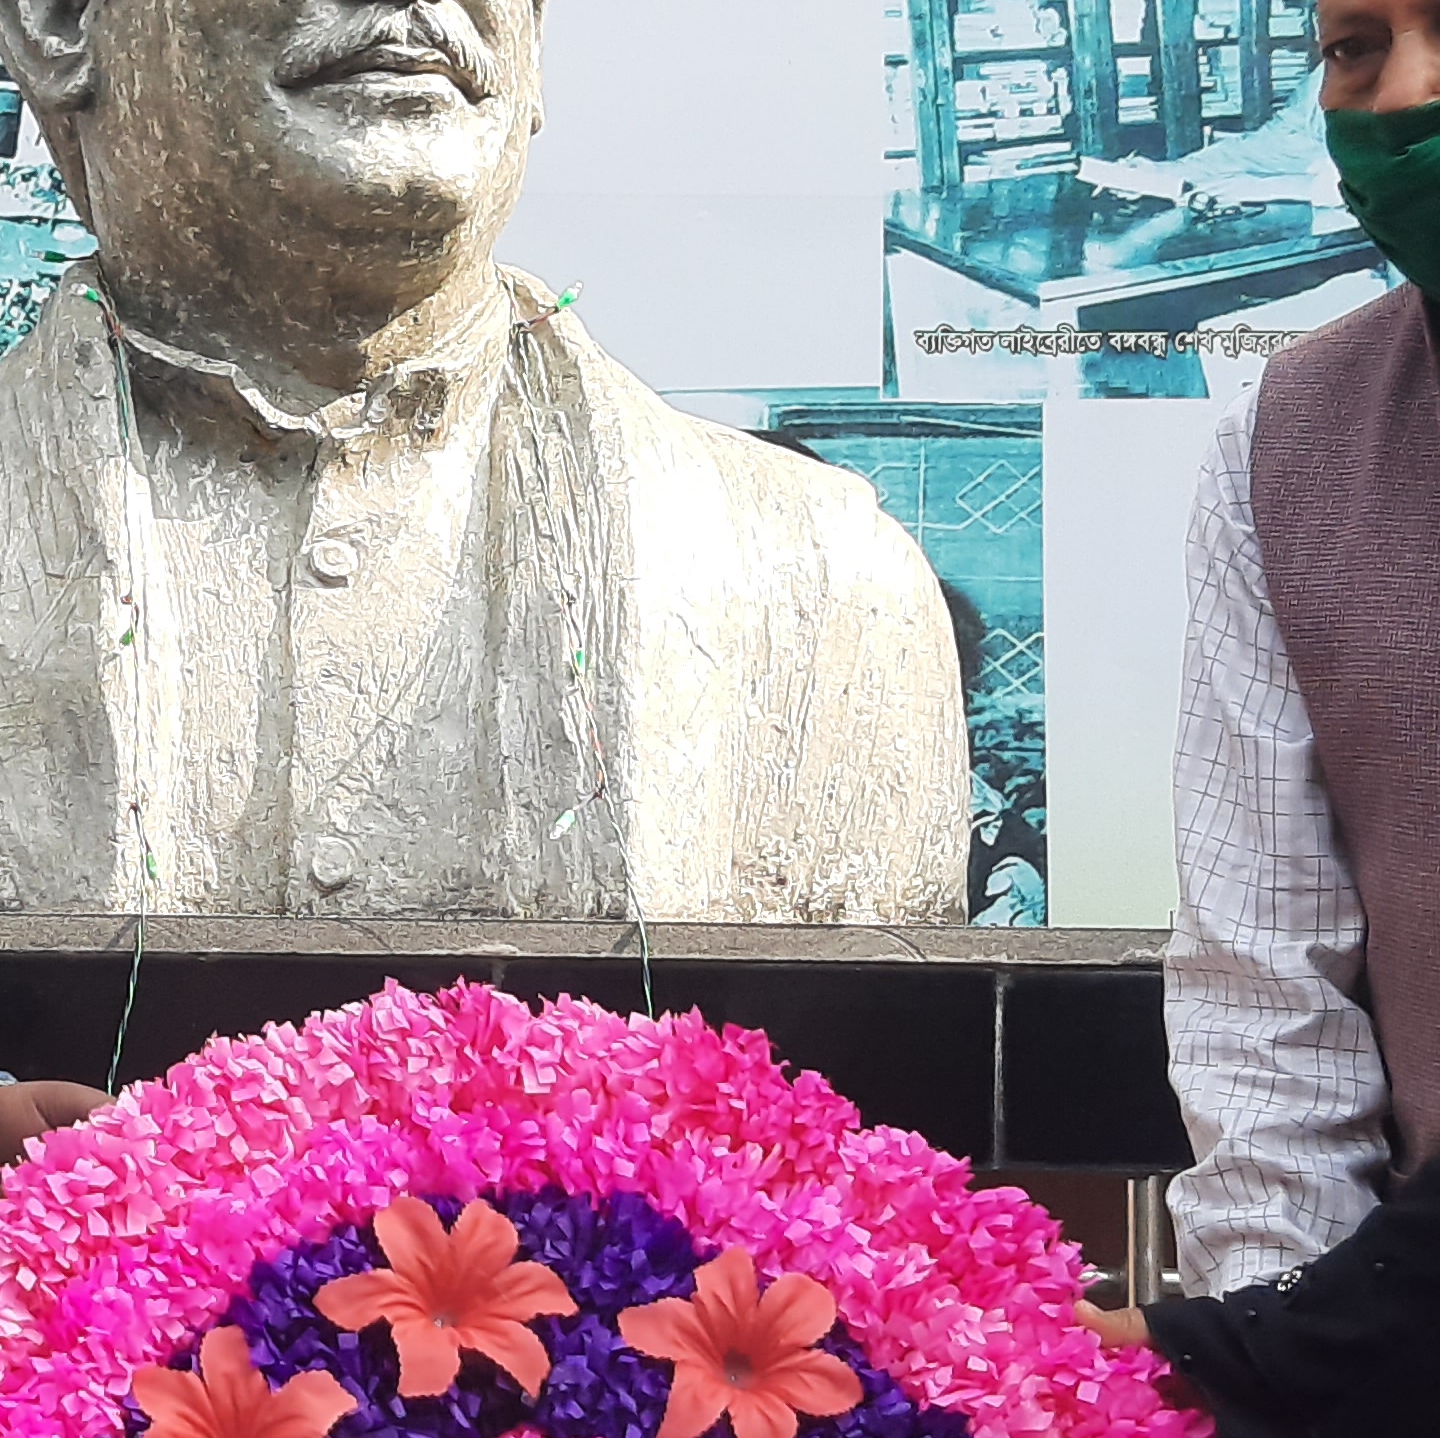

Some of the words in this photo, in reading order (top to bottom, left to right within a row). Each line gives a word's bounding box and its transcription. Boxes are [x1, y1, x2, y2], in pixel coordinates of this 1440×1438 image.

[914, 323, 995, 355] ব্যক্তিগত
[998, 323, 1103, 357] লাইব্রেরীতে
[1107, 329, 1169, 359] বঙ্গবন্ধু
[1173, 328, 1216, 355] শেখ
